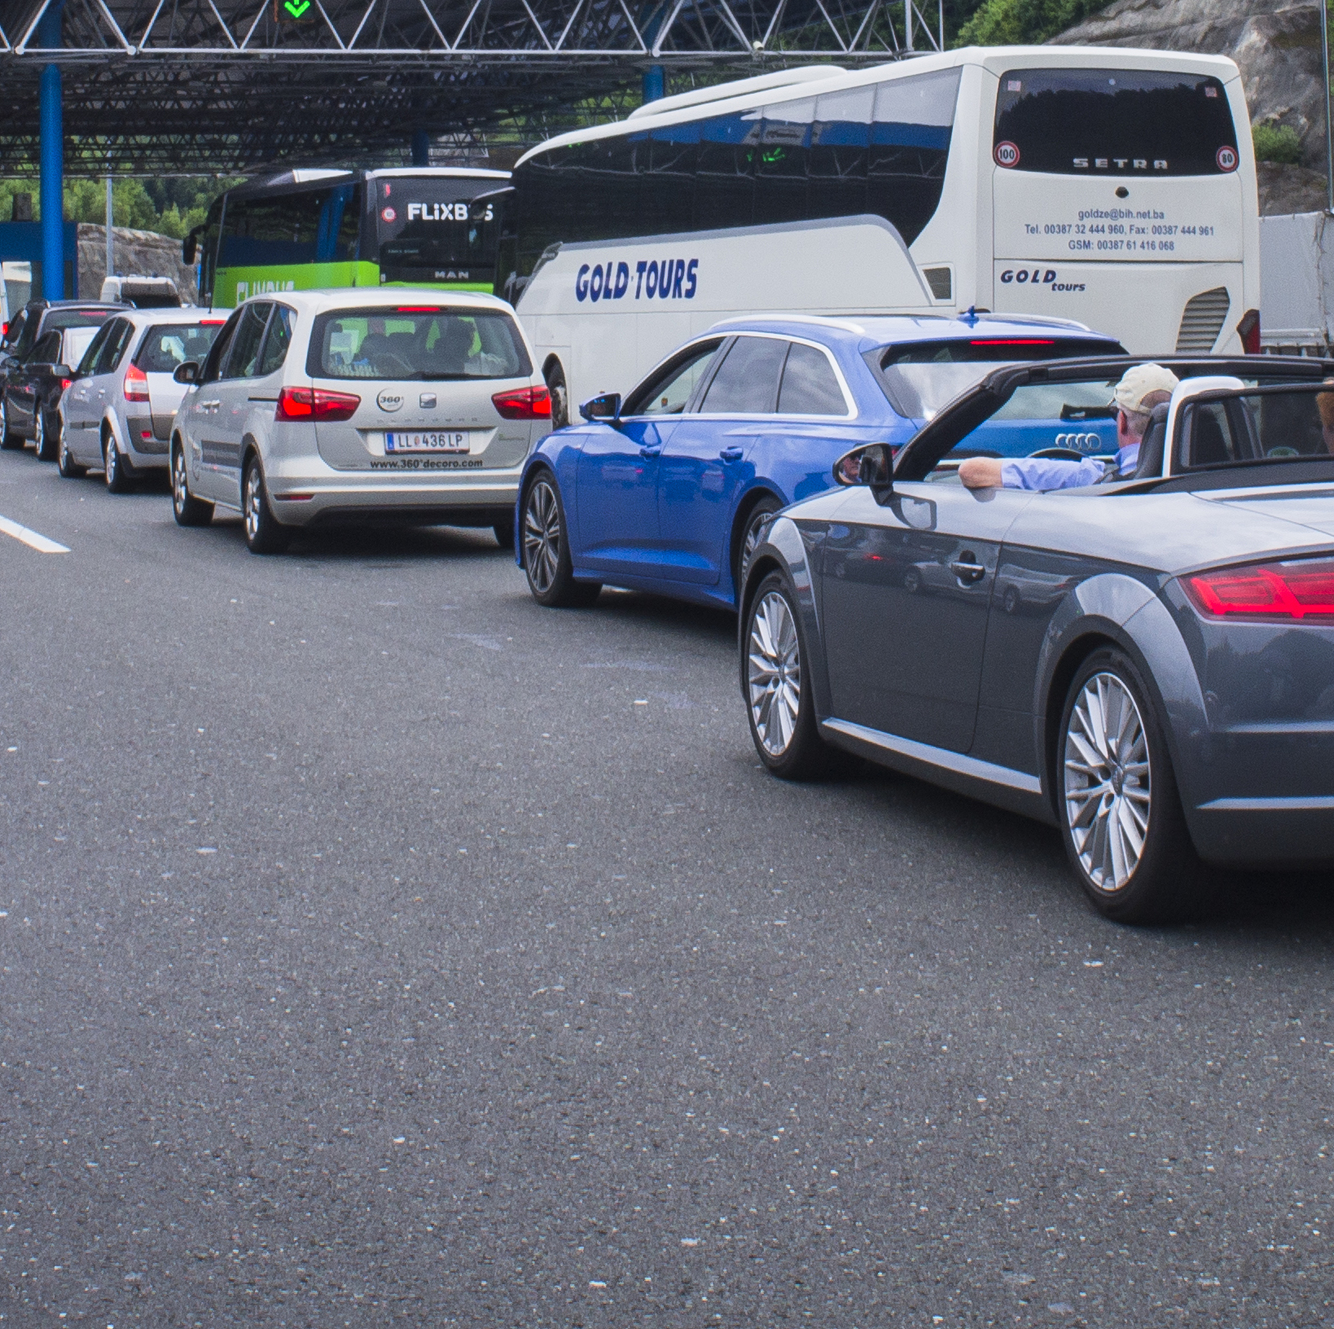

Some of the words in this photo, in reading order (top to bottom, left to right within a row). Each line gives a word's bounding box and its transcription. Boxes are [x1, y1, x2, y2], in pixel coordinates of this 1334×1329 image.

[999, 149, 1015, 160] 100
[1221, 153, 1233, 164] 80
[1073, 158, 1167, 169] SETRA
[408, 203, 493, 221] FLiXBS
[1078, 208, 1165, 221] goldze@bih.net.ba
[1024, 224, 1042, 234] Tel.
[1044, 224, 1072, 234] 00387
[1075, 224, 1086, 234] 32
[1088, 224, 1105, 234] 444
[1108, 224, 1127, 236] 960,
[1129, 224, 1149, 235] Fax:
[1151, 225, 1178, 235] 00387
[1181, 226, 1196, 235] 444
[1199, 226, 1214, 236] 961
[1068, 240, 1094, 250] GSM:
[1097, 240, 1124, 250] 00387
[1126, 240, 1136, 250] 61
[1140, 241, 1156, 251] 416
[1159, 241, 1175, 251] 068
[434, 271, 469, 279] MAN
[576, 262, 629, 303] GOLD
[635, 258, 699, 300] TOURS
[1001, 270, 1056, 283] GOLD
[1051, 282, 1085, 291] tours
[398, 434, 412, 447] LL
[422, 433, 445, 447] 436
[449, 432, 463, 446] LP
